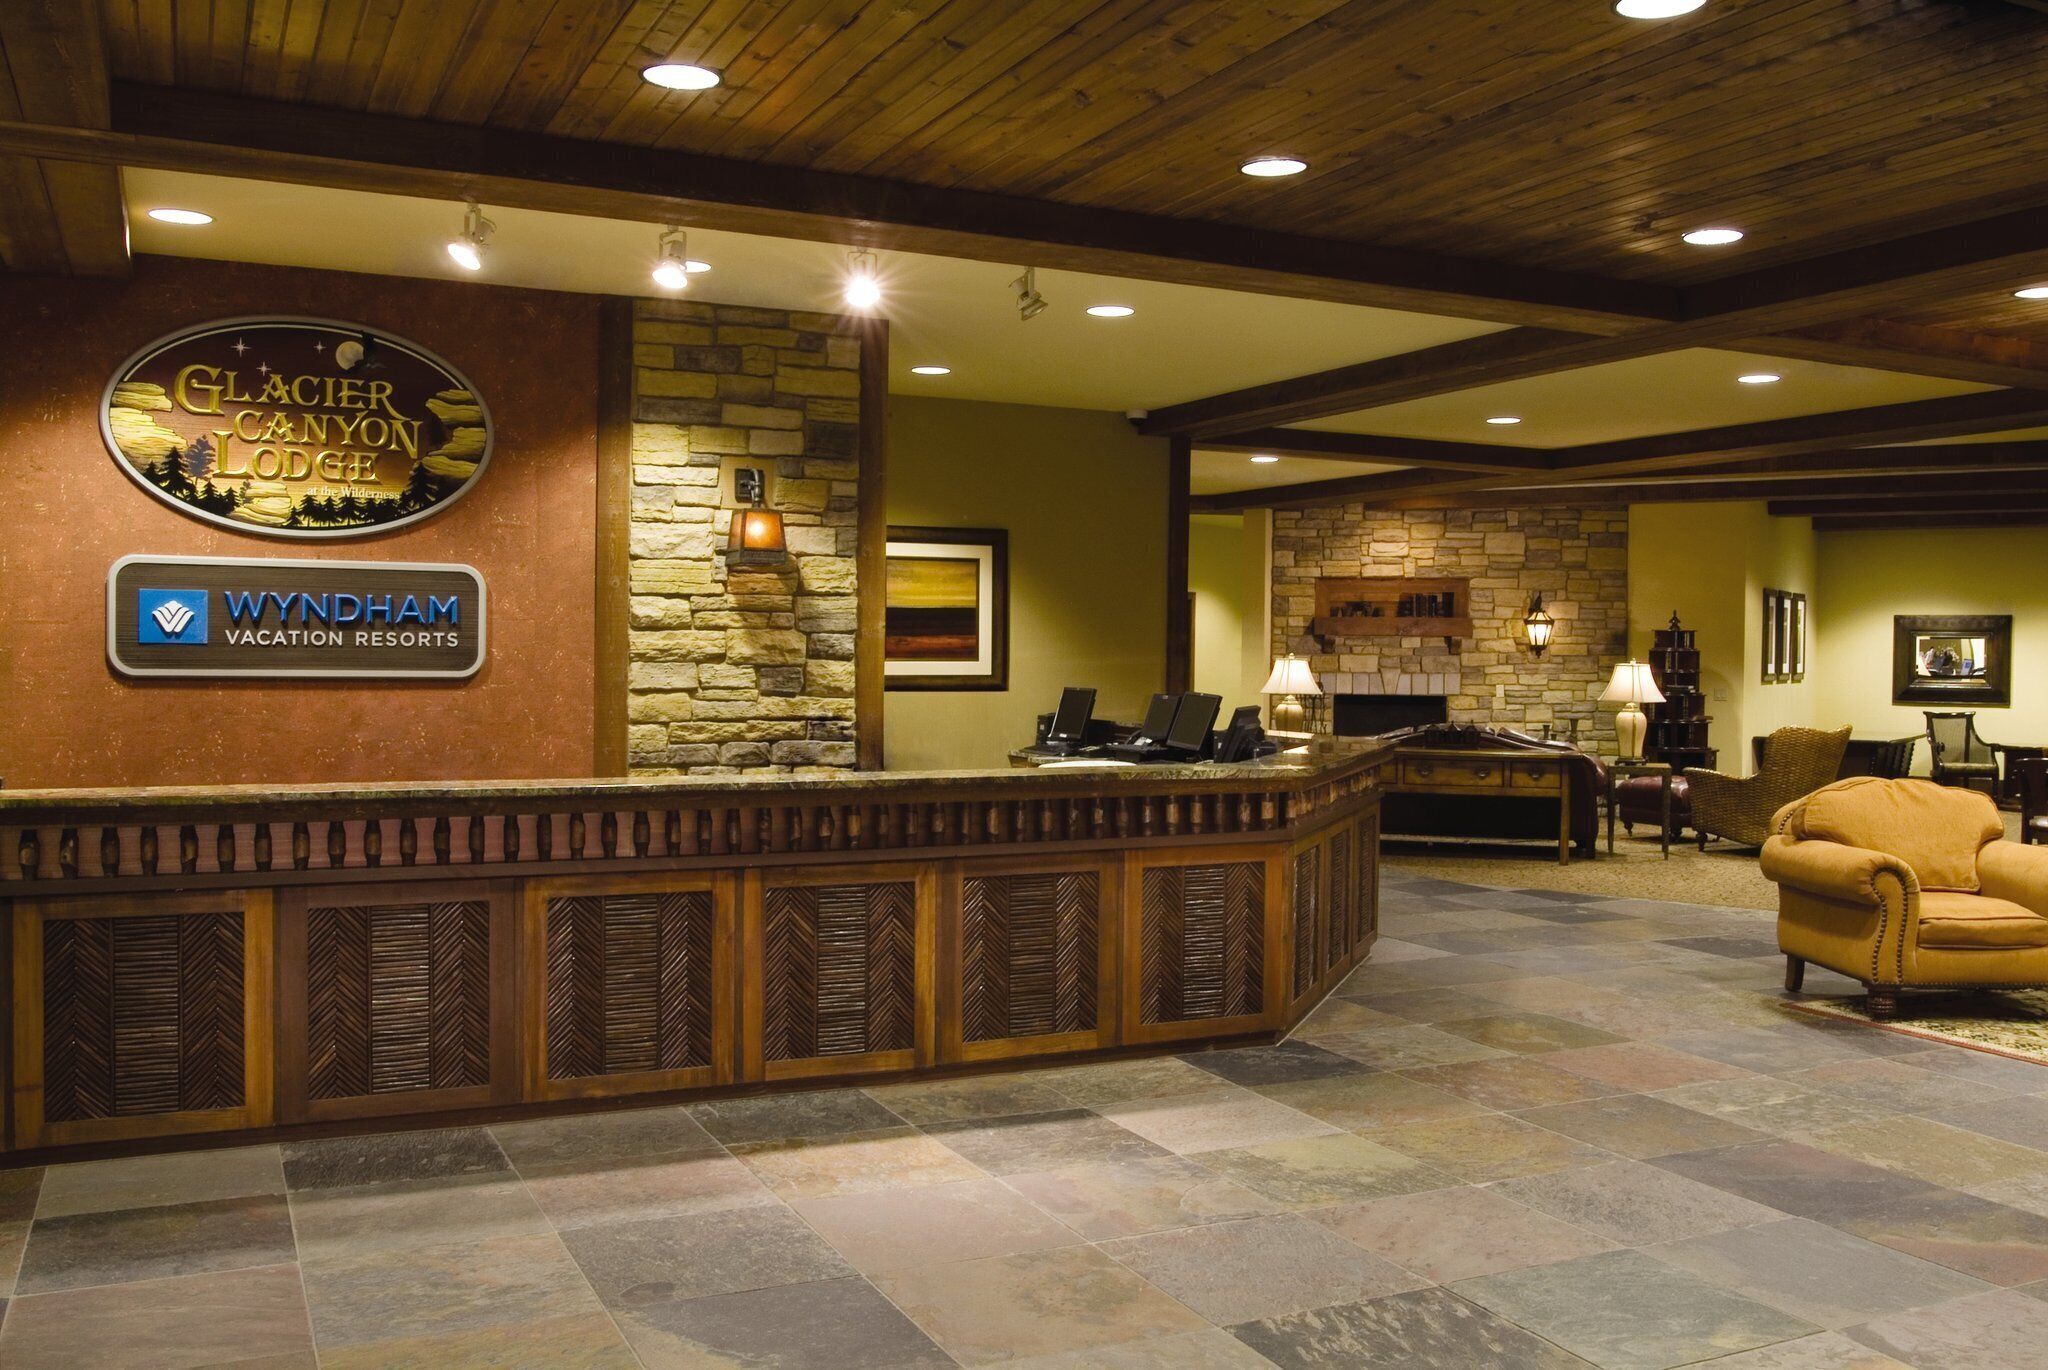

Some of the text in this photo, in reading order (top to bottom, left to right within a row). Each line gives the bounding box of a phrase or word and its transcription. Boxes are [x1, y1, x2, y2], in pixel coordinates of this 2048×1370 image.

[174, 364, 411, 420] GLACIER
[233, 410, 424, 459] CANYON
[212, 430, 380, 481] LODGE
[307, 485, 400, 500] at the Wilderness
[224, 591, 458, 625] WYNDHAM
[225, 629, 459, 647] VACATION RESORTS
